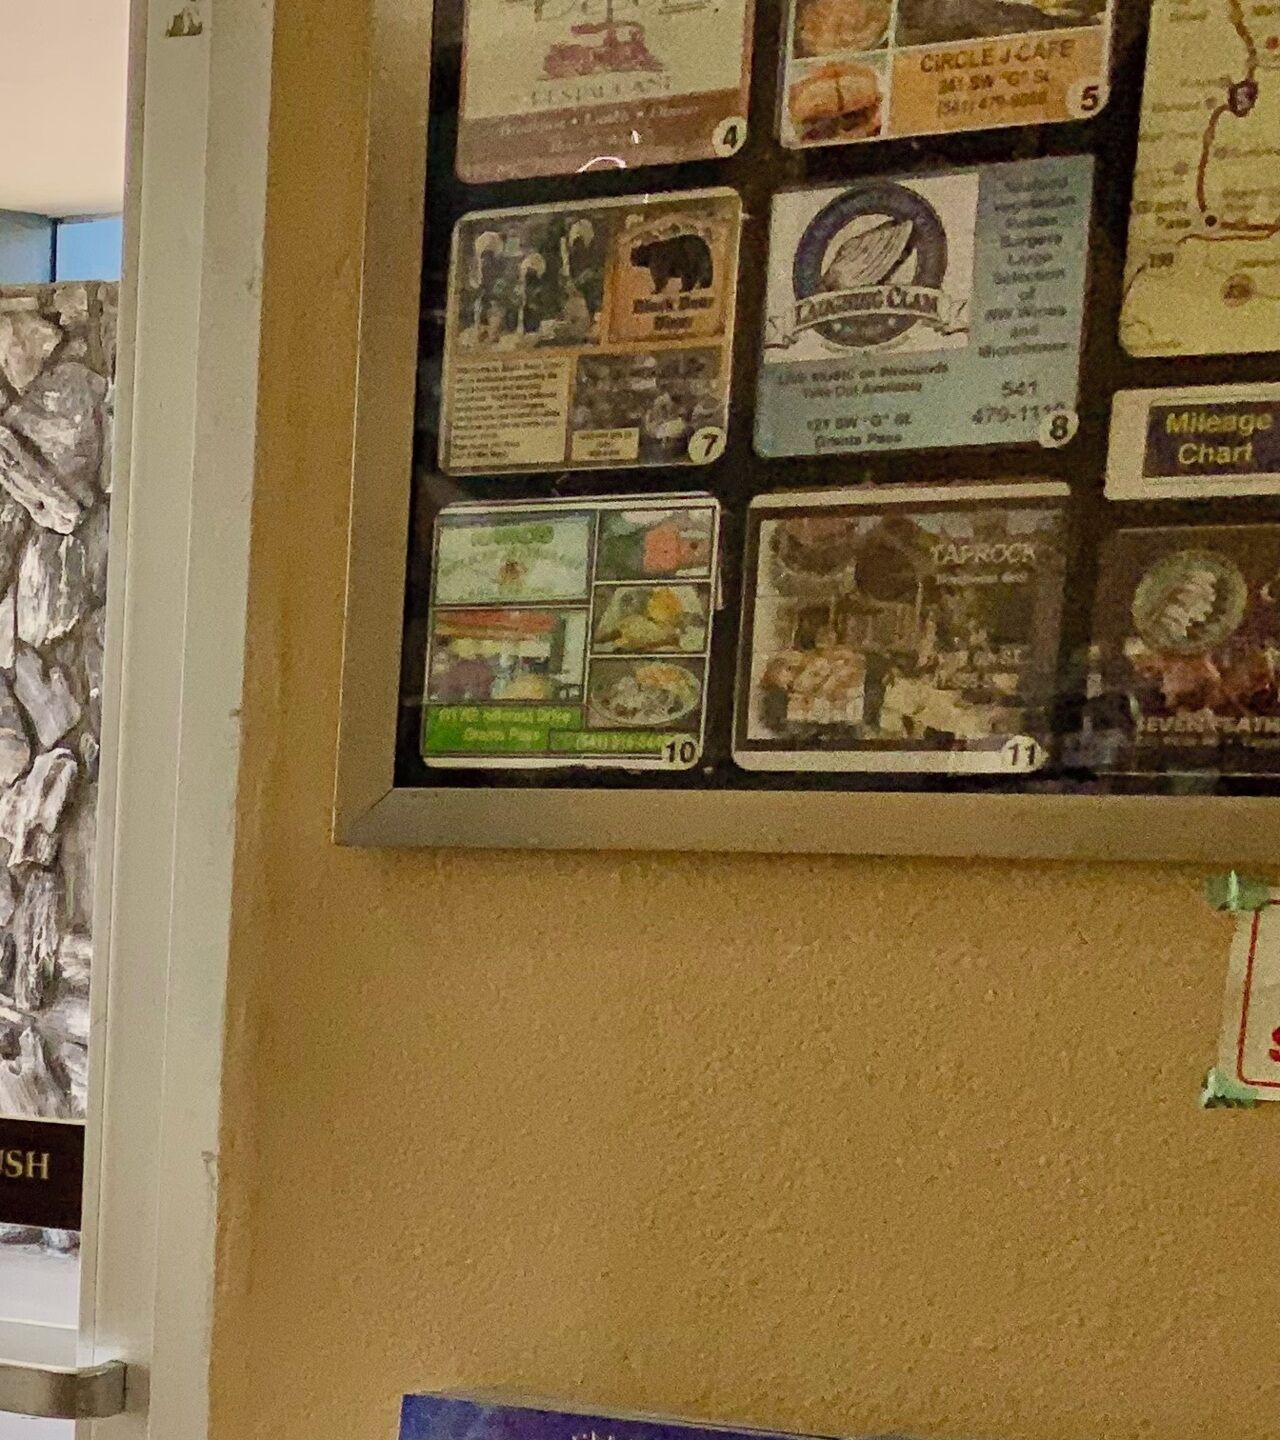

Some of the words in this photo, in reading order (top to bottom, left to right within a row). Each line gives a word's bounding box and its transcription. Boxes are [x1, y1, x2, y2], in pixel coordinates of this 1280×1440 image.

[920, 46, 994, 73] CIRCLE
[1014, 38, 1077, 62] CAFE
[1081, 85, 1100, 112] 5
[723, 125, 738, 149] 4
[1049, 413, 1069, 441] 8
[1165, 409, 1273, 437] Mileage
[703, 433, 719, 458] 7
[1177, 441, 1254, 466] Chart
[665, 741, 696, 763] 10
[1007, 743, 1037, 766] 11
